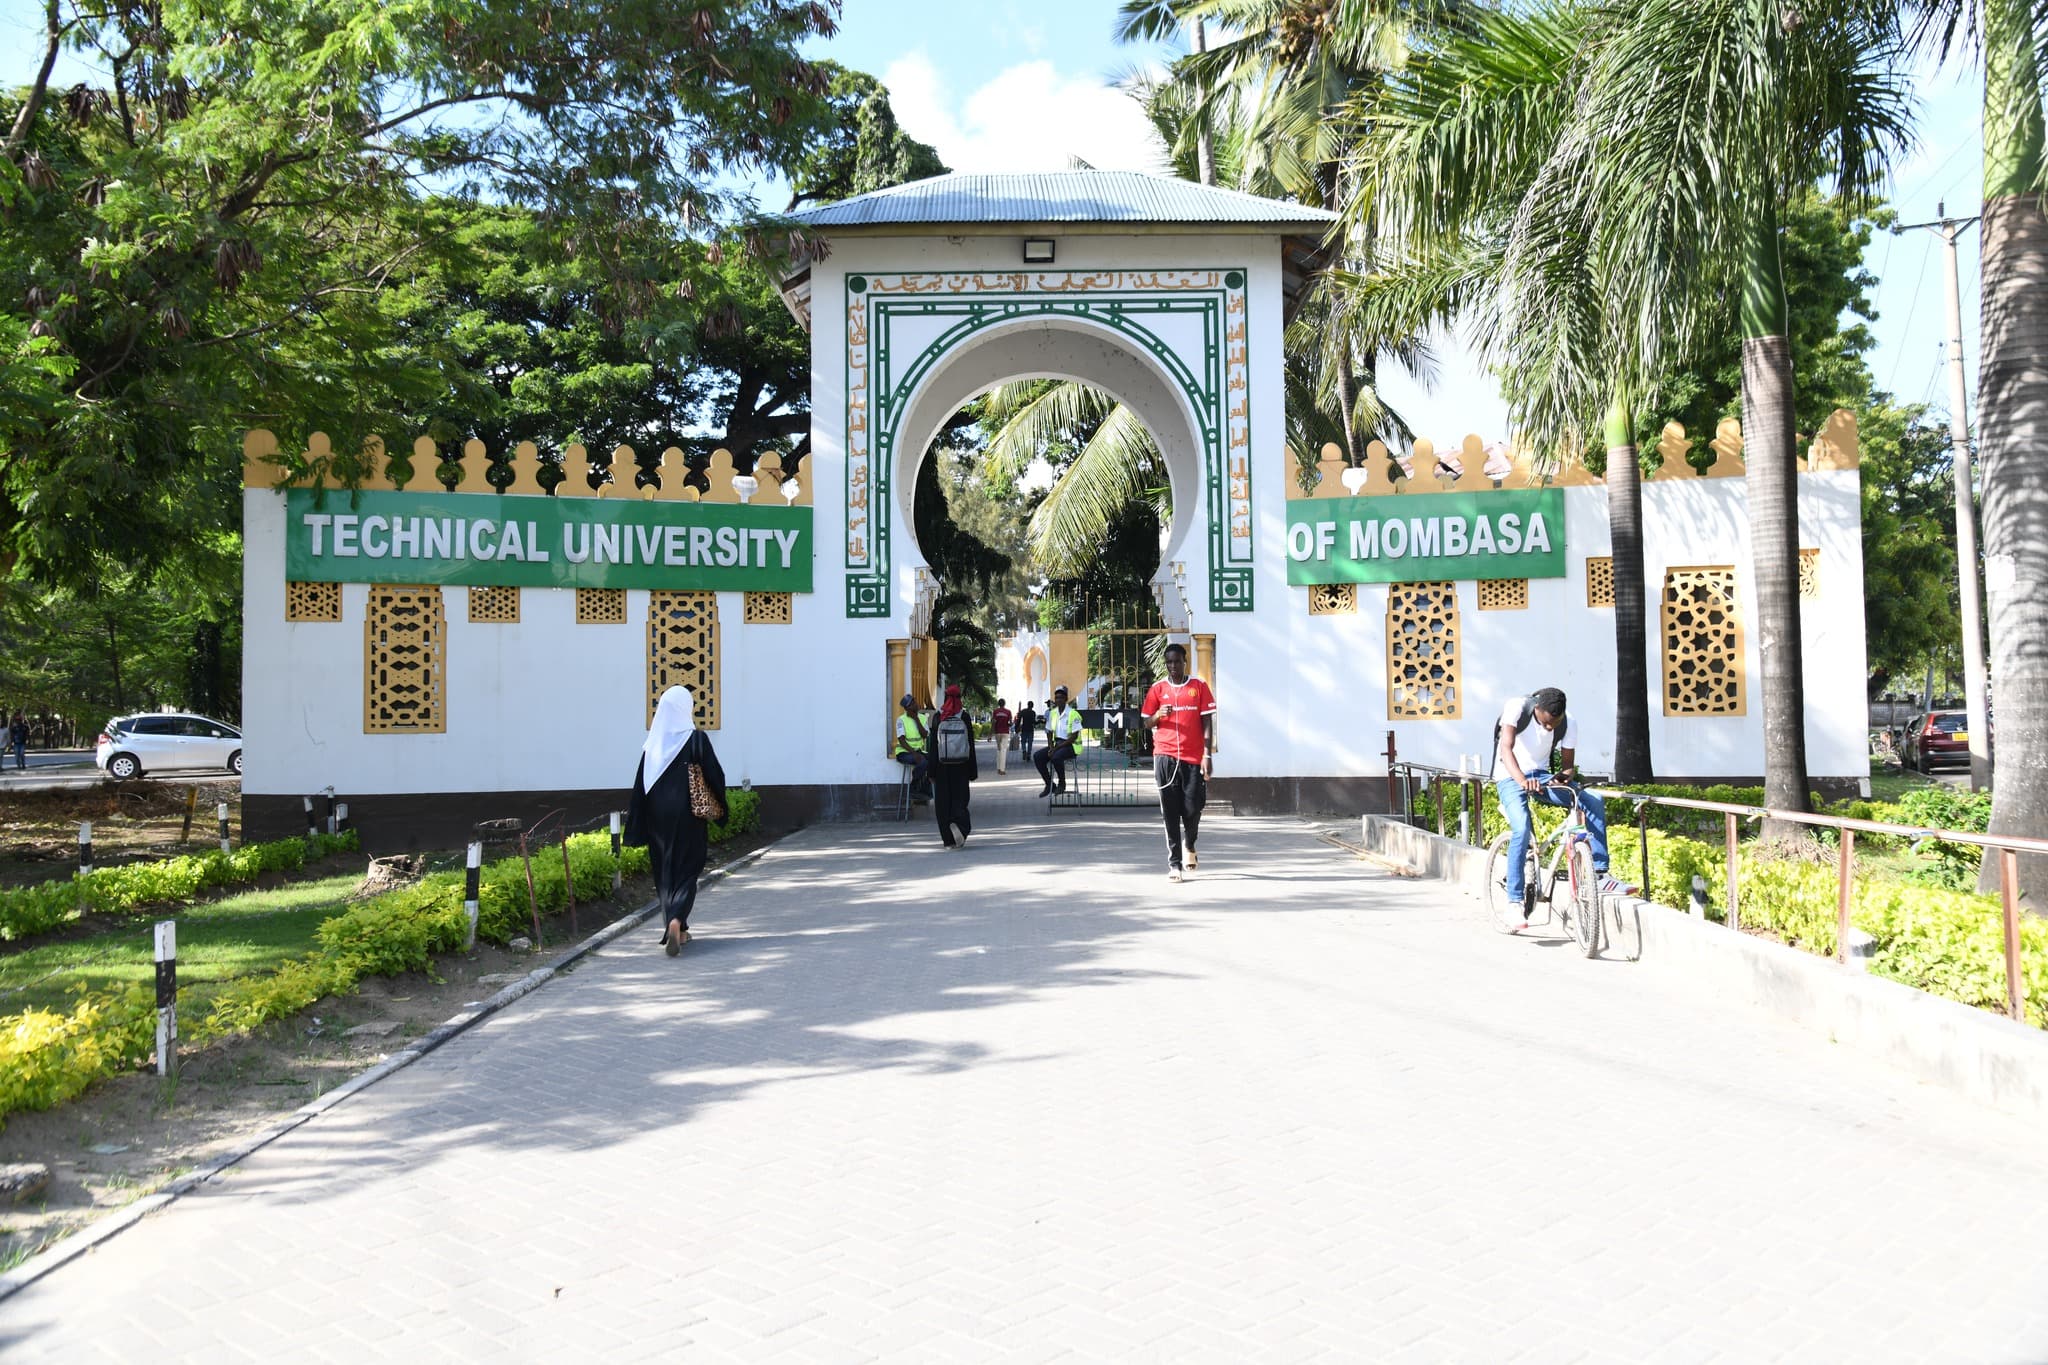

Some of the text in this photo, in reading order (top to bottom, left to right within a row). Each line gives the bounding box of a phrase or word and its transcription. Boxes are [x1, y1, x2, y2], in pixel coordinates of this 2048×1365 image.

[303, 513, 800, 568] TECHNICAL UNIVERSITY
[1287, 512, 1552, 562] OF MOMBASA
[1103, 712, 1124, 729] M
